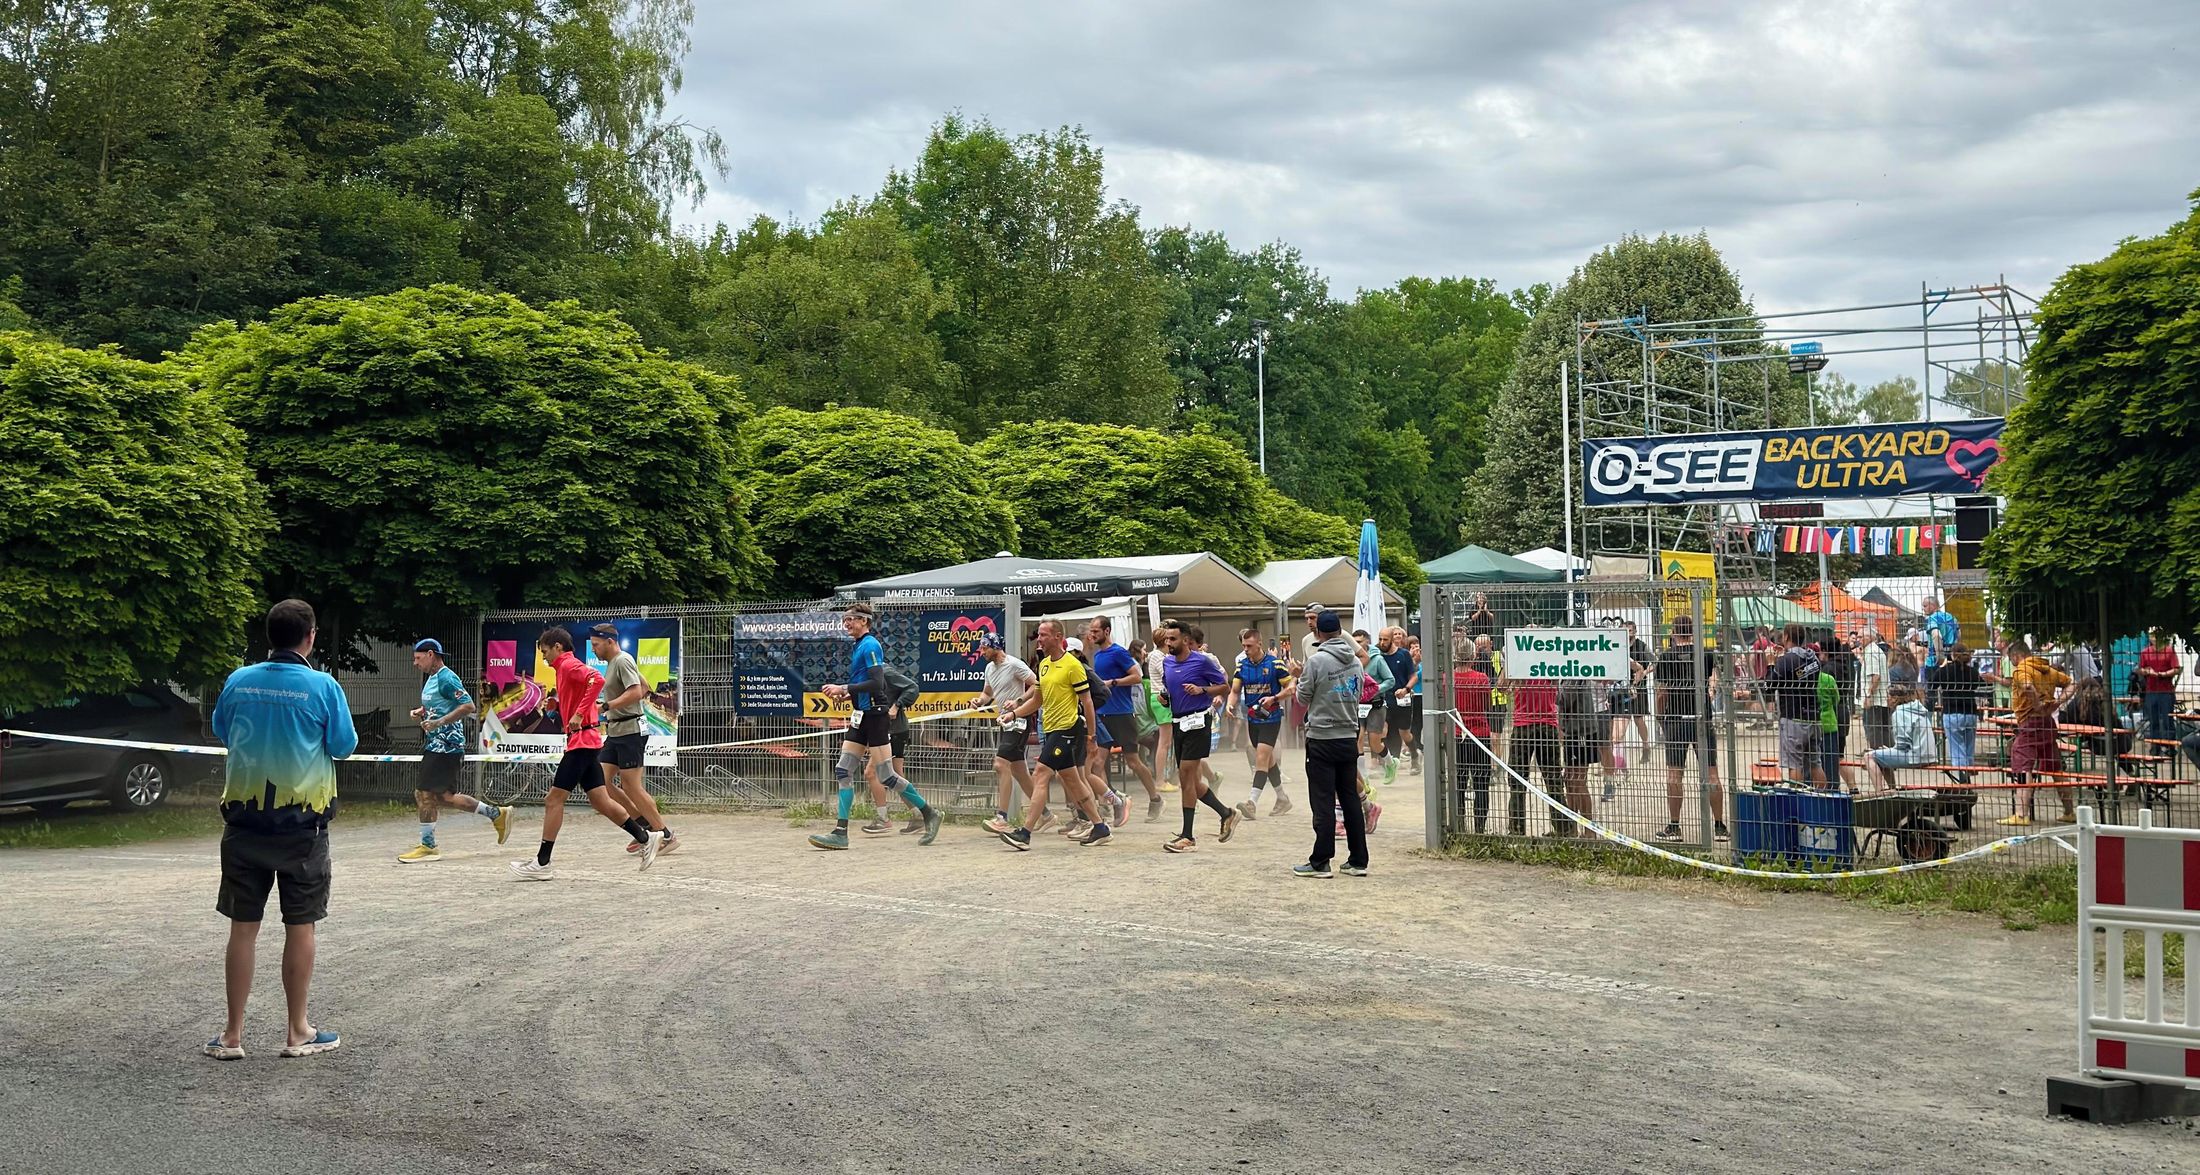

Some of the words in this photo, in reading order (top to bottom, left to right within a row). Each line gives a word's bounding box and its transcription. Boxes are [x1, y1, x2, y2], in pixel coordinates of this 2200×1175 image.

[1764, 429, 1951, 463] BACKYARD
[1597, 445, 1754, 488] O-SEE
[1796, 461, 1908, 490] ULTRA
[1002, 586, 1021, 595] SEIT
[1022, 584, 1042, 595] 1869
[1044, 583, 1062, 594] AUS
[1063, 581, 1099, 593] GÖRLITZ
[1132, 579, 1145, 590] IMMER
[1153, 577, 1170, 588] GENUSS
[884, 589, 911, 598] IMMER
[911, 588, 924, 598] EIN
[924, 588, 955, 597] GENUSS
[928, 622, 949, 631] O-SEE
[928, 630, 985, 642] BACKYARD
[938, 642, 972, 653] ULTRA
[1514, 634, 1620, 656] Westpark-
[489, 658, 513, 667] STROM
[587, 657, 608, 666] WASS
[639, 654, 668, 665] WÄRME
[1529, 659, 1606, 677] stadion
[922, 671, 948, 682] 11./12.
[949, 669, 966, 681] Juli
[968, 671, 985, 681] 202
[832, 701, 851, 712] Wie
[914, 700, 952, 712] schaffst
[496, 743, 550, 754] STADTWERKE
[551, 744, 564, 754] ZIT
